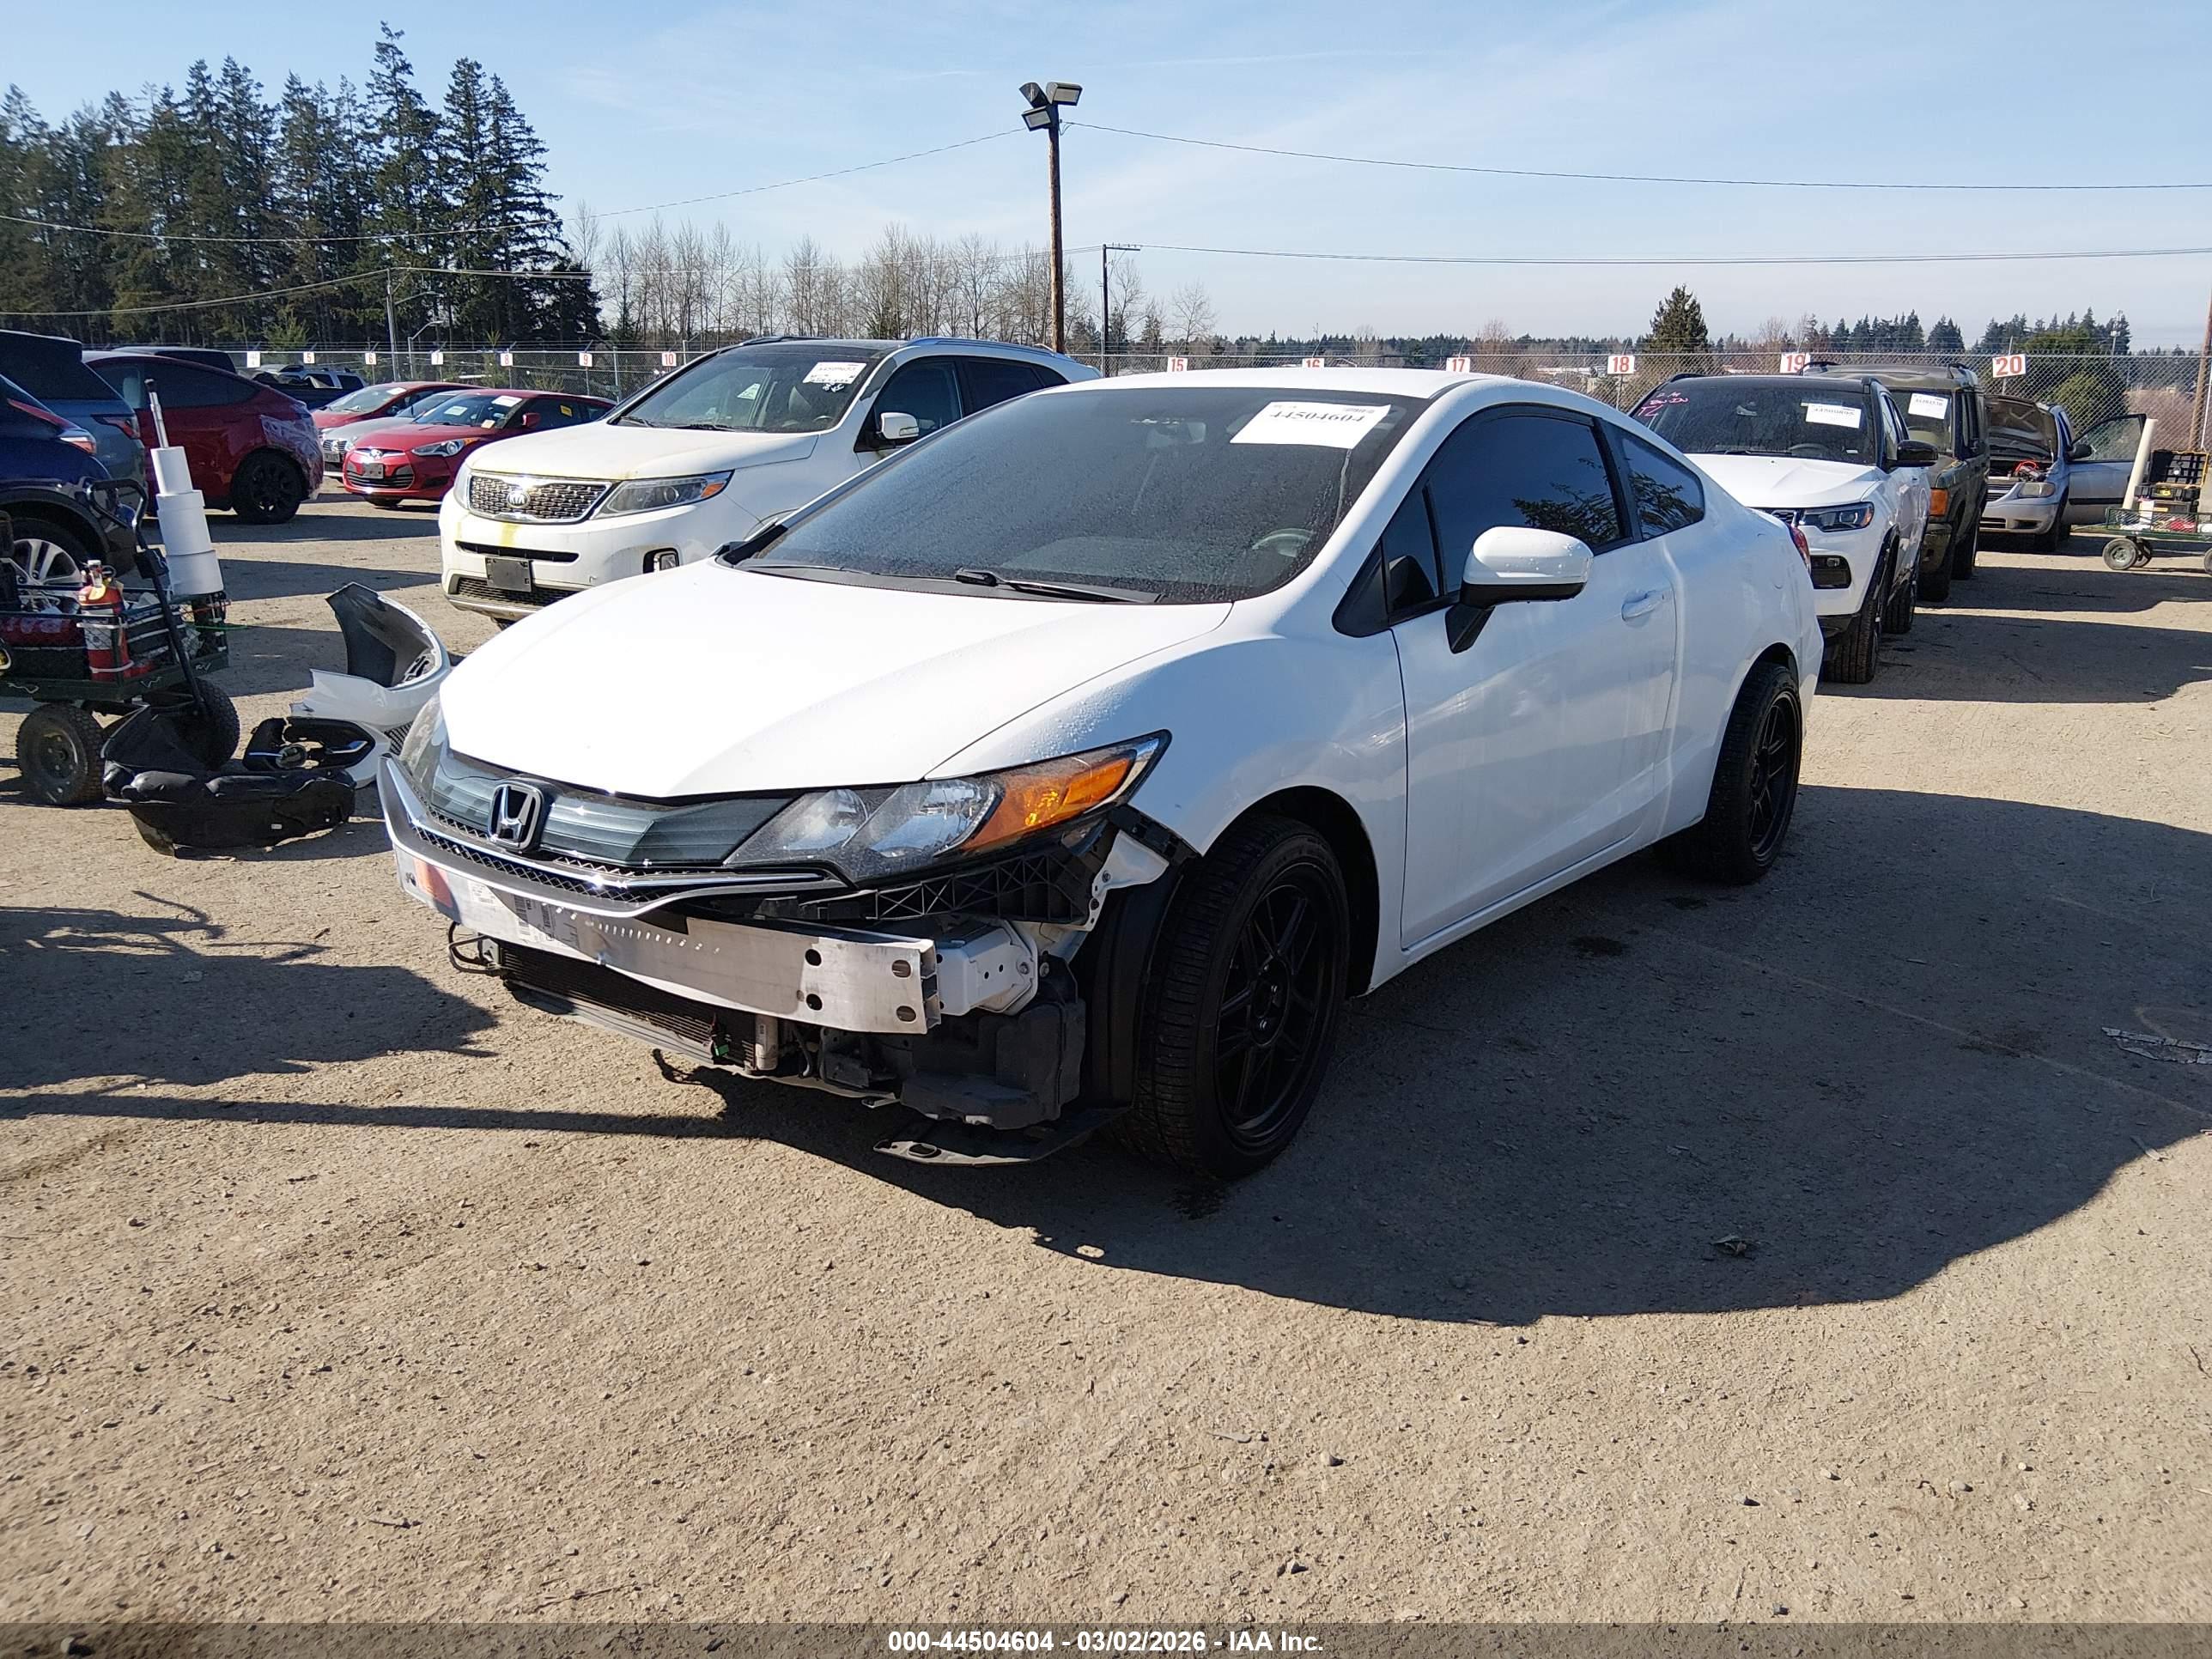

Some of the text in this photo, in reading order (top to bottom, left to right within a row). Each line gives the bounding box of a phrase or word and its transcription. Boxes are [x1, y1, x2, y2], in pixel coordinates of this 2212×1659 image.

[307, 353, 312, 363] 5
[368, 353, 374, 363] 6
[504, 355, 510, 365] 8
[583, 355, 588, 365] 9
[664, 354, 674, 365] 10
[1451, 357, 1466, 371] 17
[1786, 354, 1804, 372] 19
[1171, 358, 1184, 372] 15
[1612, 356, 1630, 373] 18
[1996, 356, 2022, 376] 20
[1270, 410, 1366, 422] 44504604
